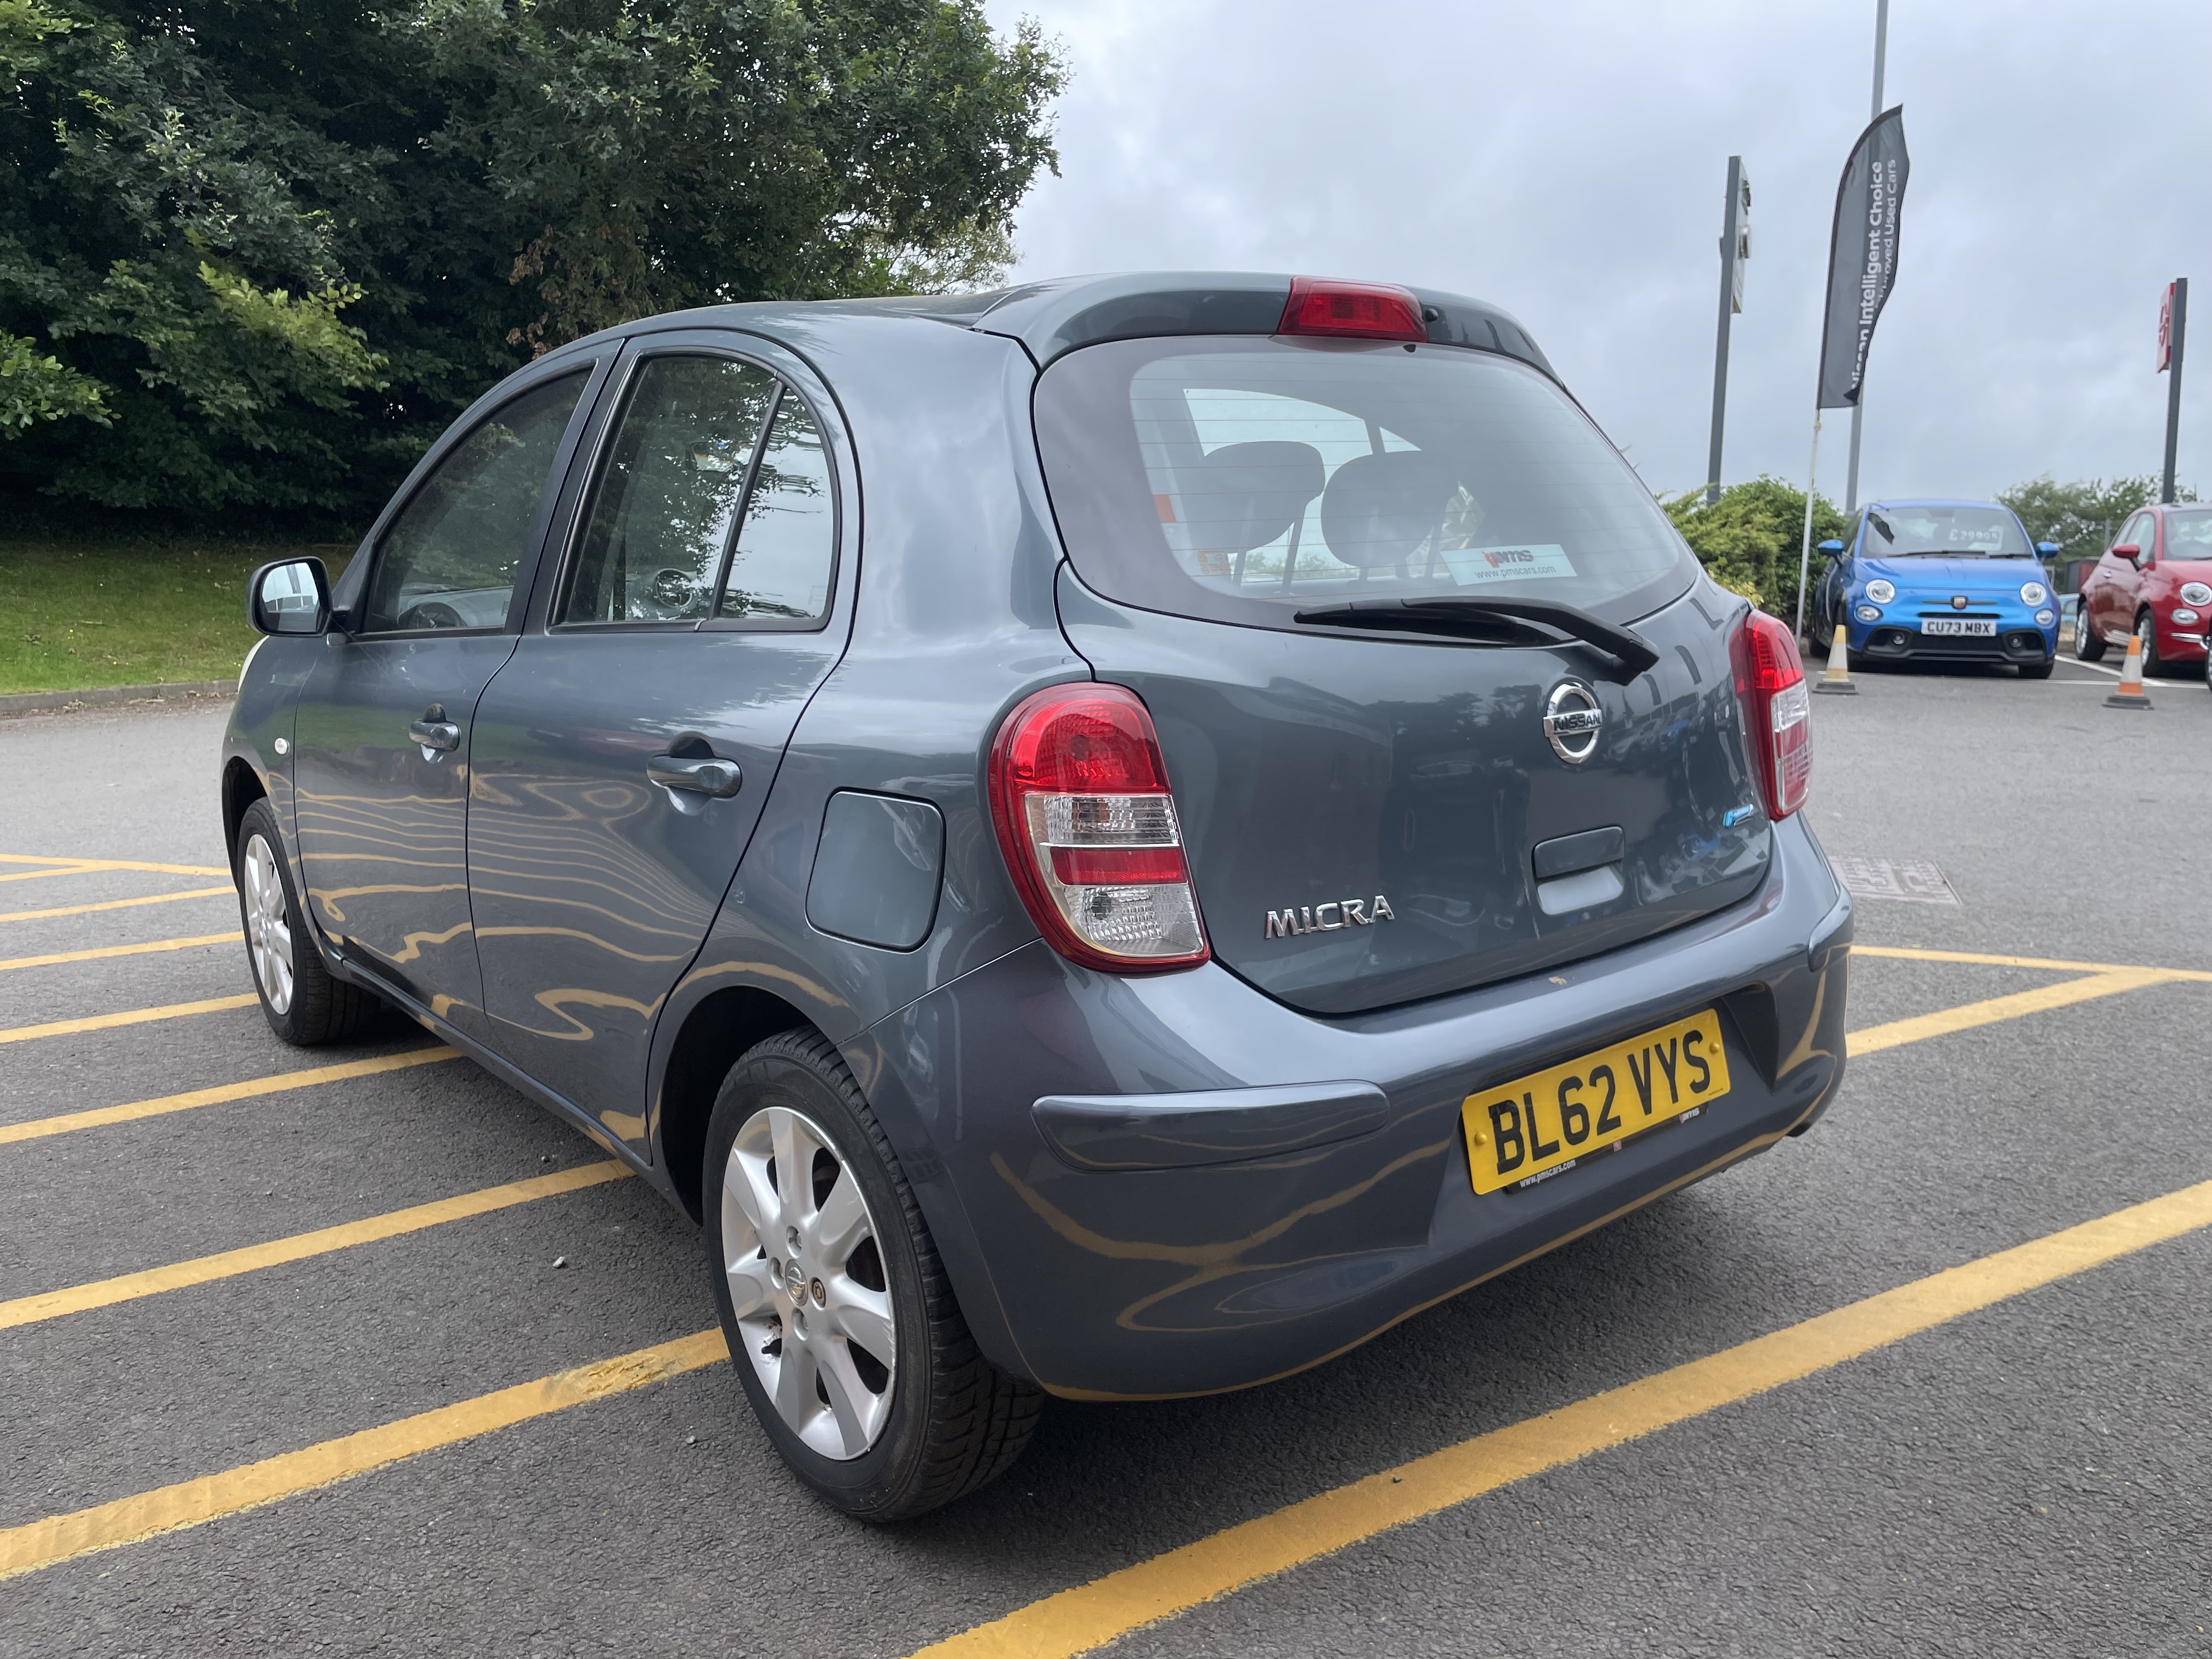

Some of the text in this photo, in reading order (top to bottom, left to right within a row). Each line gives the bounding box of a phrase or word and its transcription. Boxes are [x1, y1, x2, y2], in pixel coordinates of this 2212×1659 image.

[1870, 161, 1883, 226] Choice
[1875, 160, 1897, 308] roved Used Cars
[1859, 230, 1882, 324] Intelligent
[1475, 566, 1556, 578] www.pmscars.com
[1927, 621, 1990, 634] CU73 MBX
[1554, 714, 1601, 731] NISSAN
[1265, 895, 1395, 939] MICRA
[1488, 1030, 1711, 1175] BL62 VYS
[1520, 1159, 1576, 1188] www.pmscars.com
